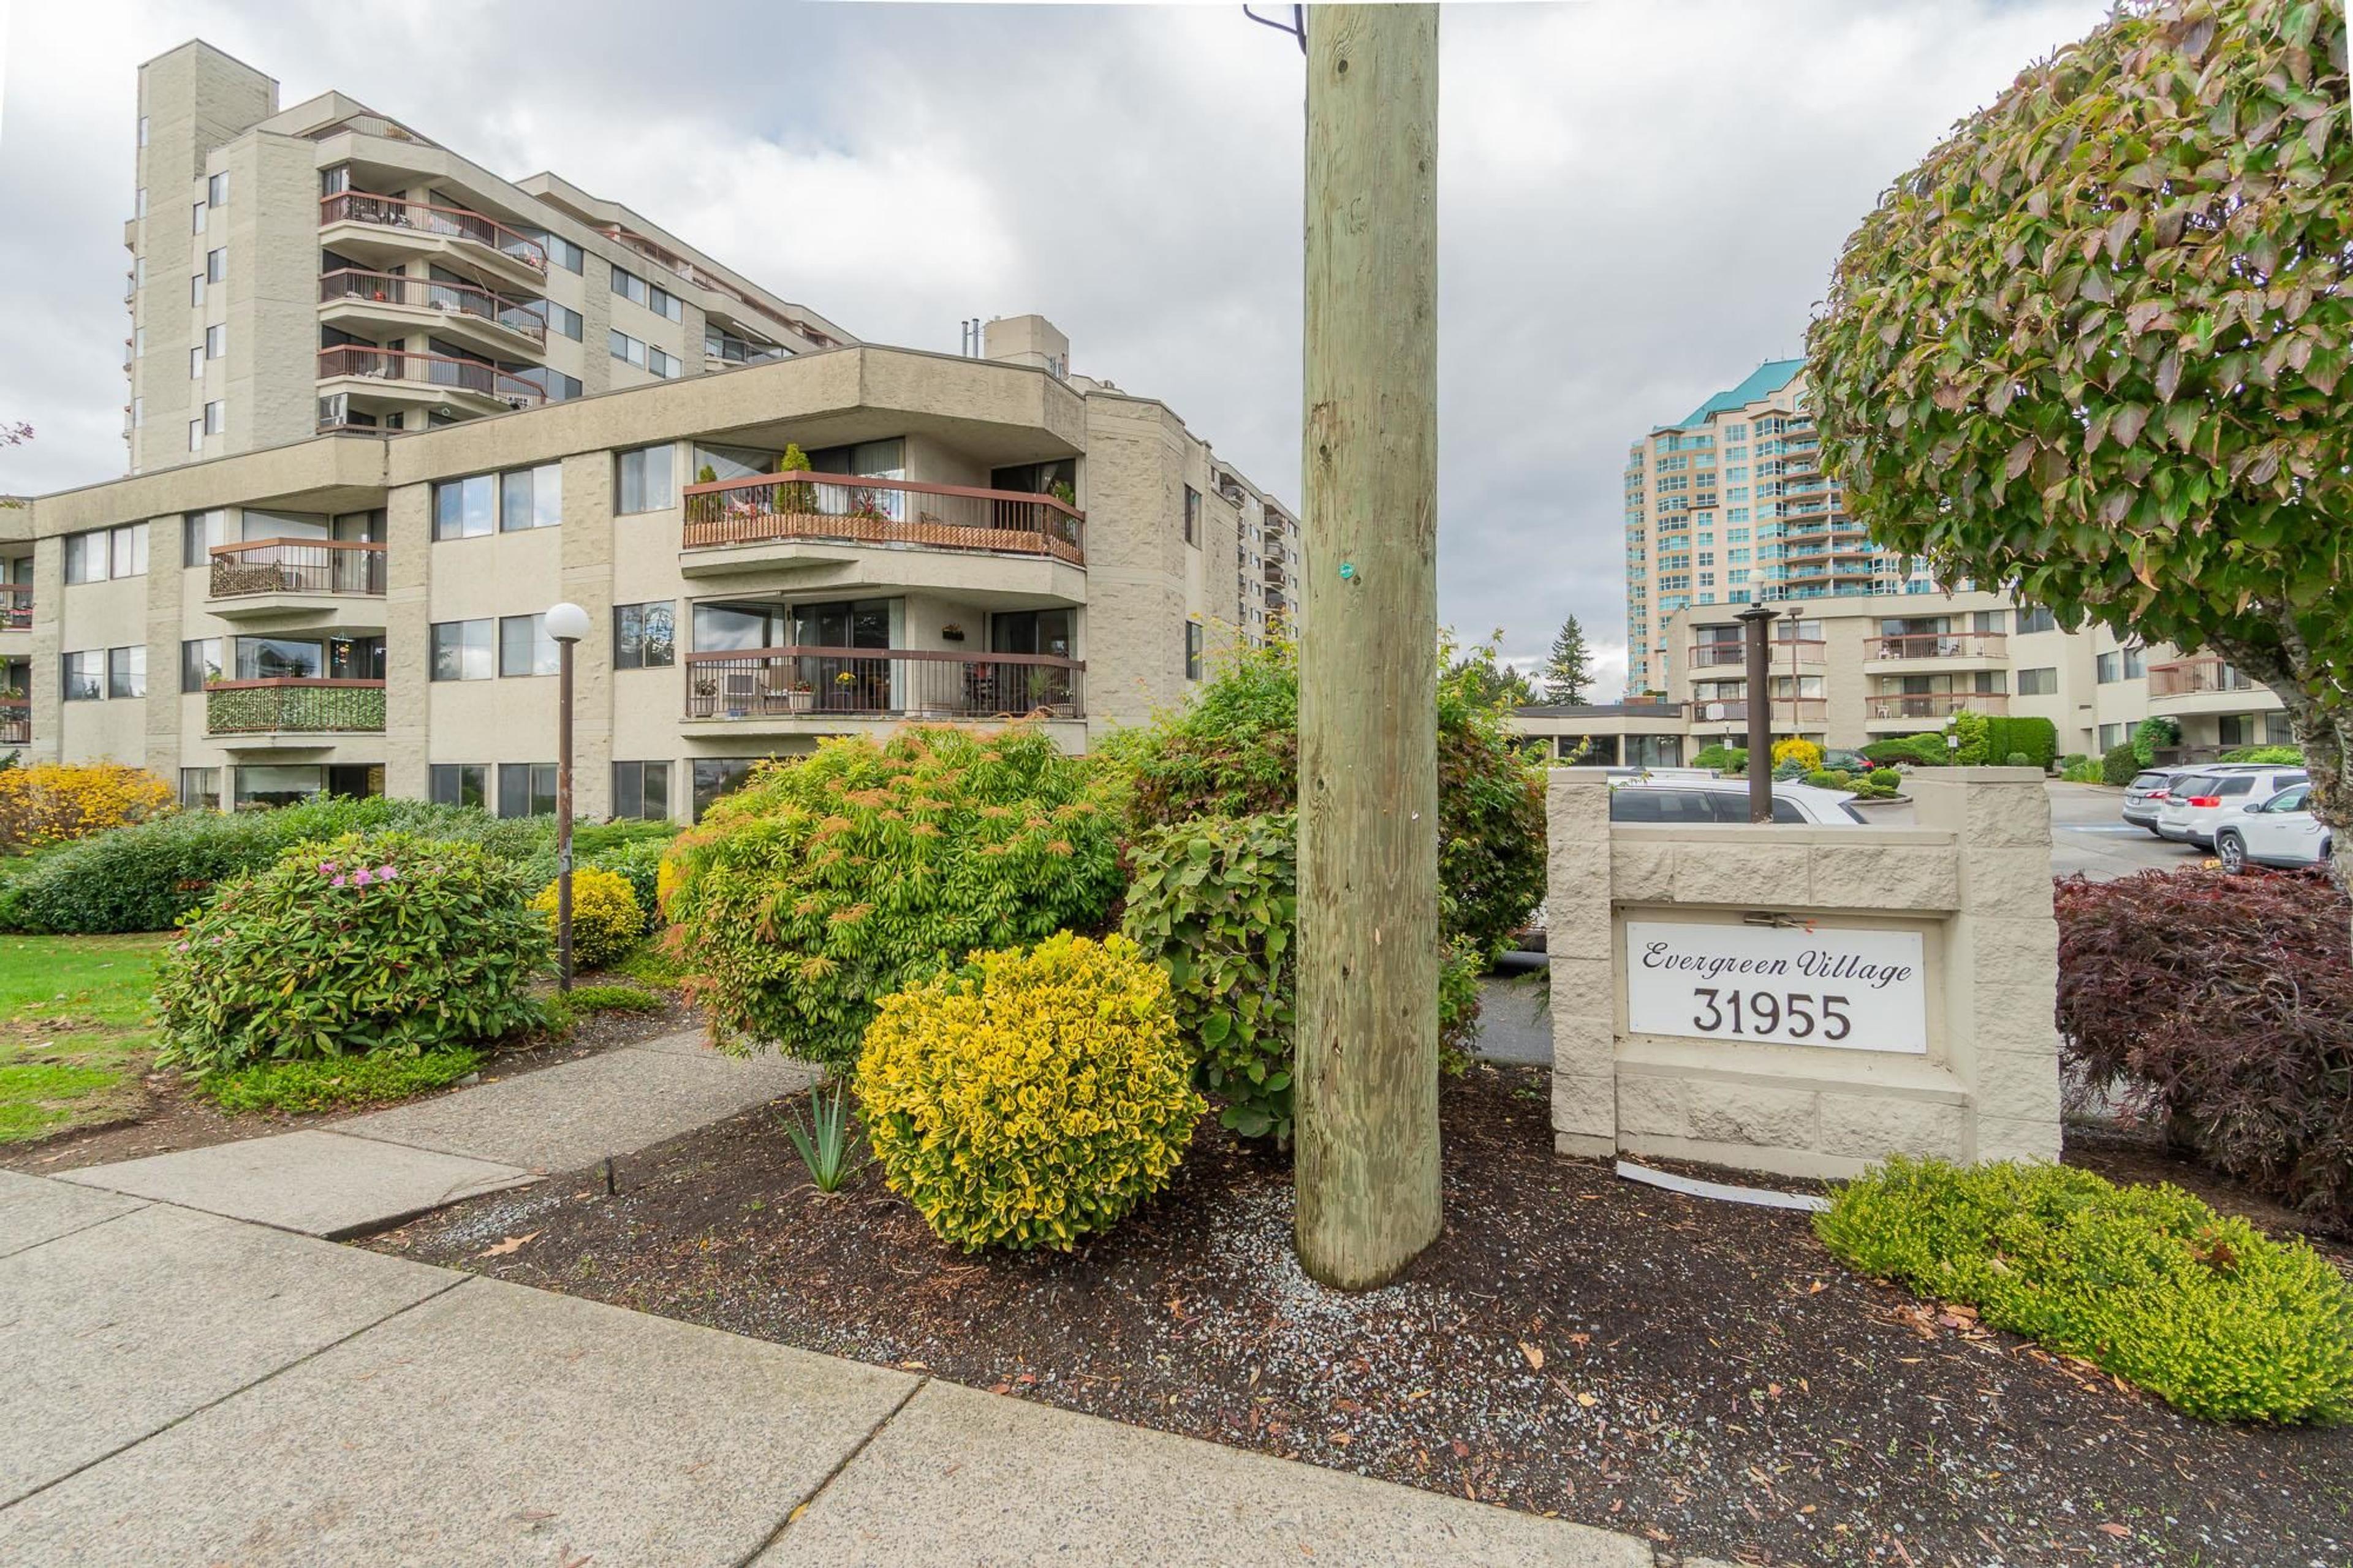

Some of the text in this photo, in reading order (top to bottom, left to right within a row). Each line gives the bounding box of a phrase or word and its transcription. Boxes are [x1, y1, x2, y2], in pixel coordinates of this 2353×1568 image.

[1643, 942, 1912, 989] Evergreen Village
[1693, 988, 1851, 1040] 31955
